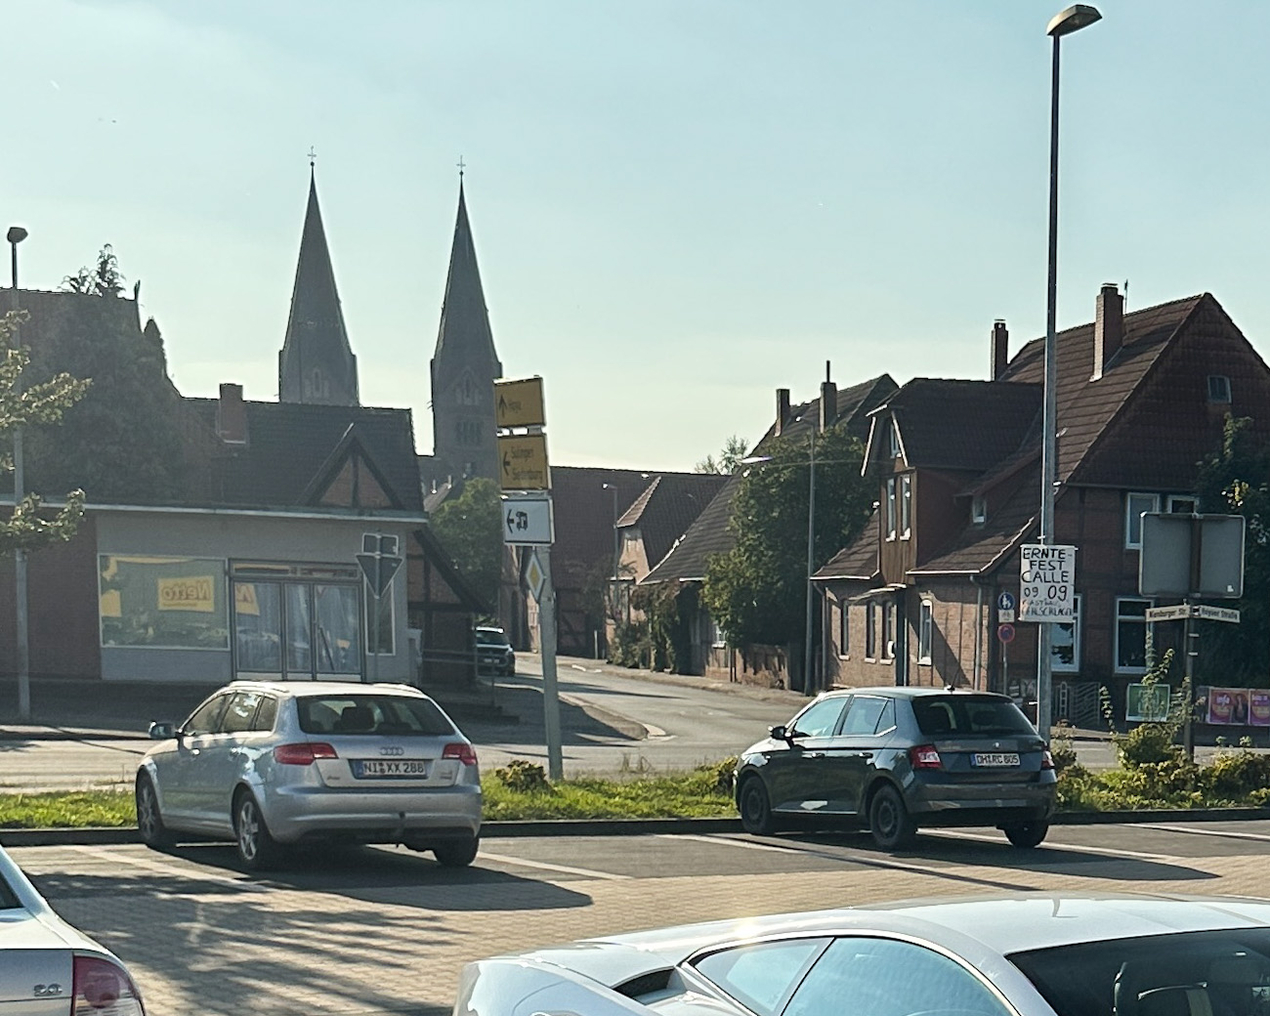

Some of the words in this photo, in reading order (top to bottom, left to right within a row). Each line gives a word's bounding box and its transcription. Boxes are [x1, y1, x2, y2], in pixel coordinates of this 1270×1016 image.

[1022, 547, 1073, 560] ERNTE-
[1029, 560, 1067, 571] FEST
[1021, 570, 1070, 584] CALLE
[1047, 585, 1068, 602] 09
[364, 762, 378, 772] NI
[387, 762, 401, 772] XX
